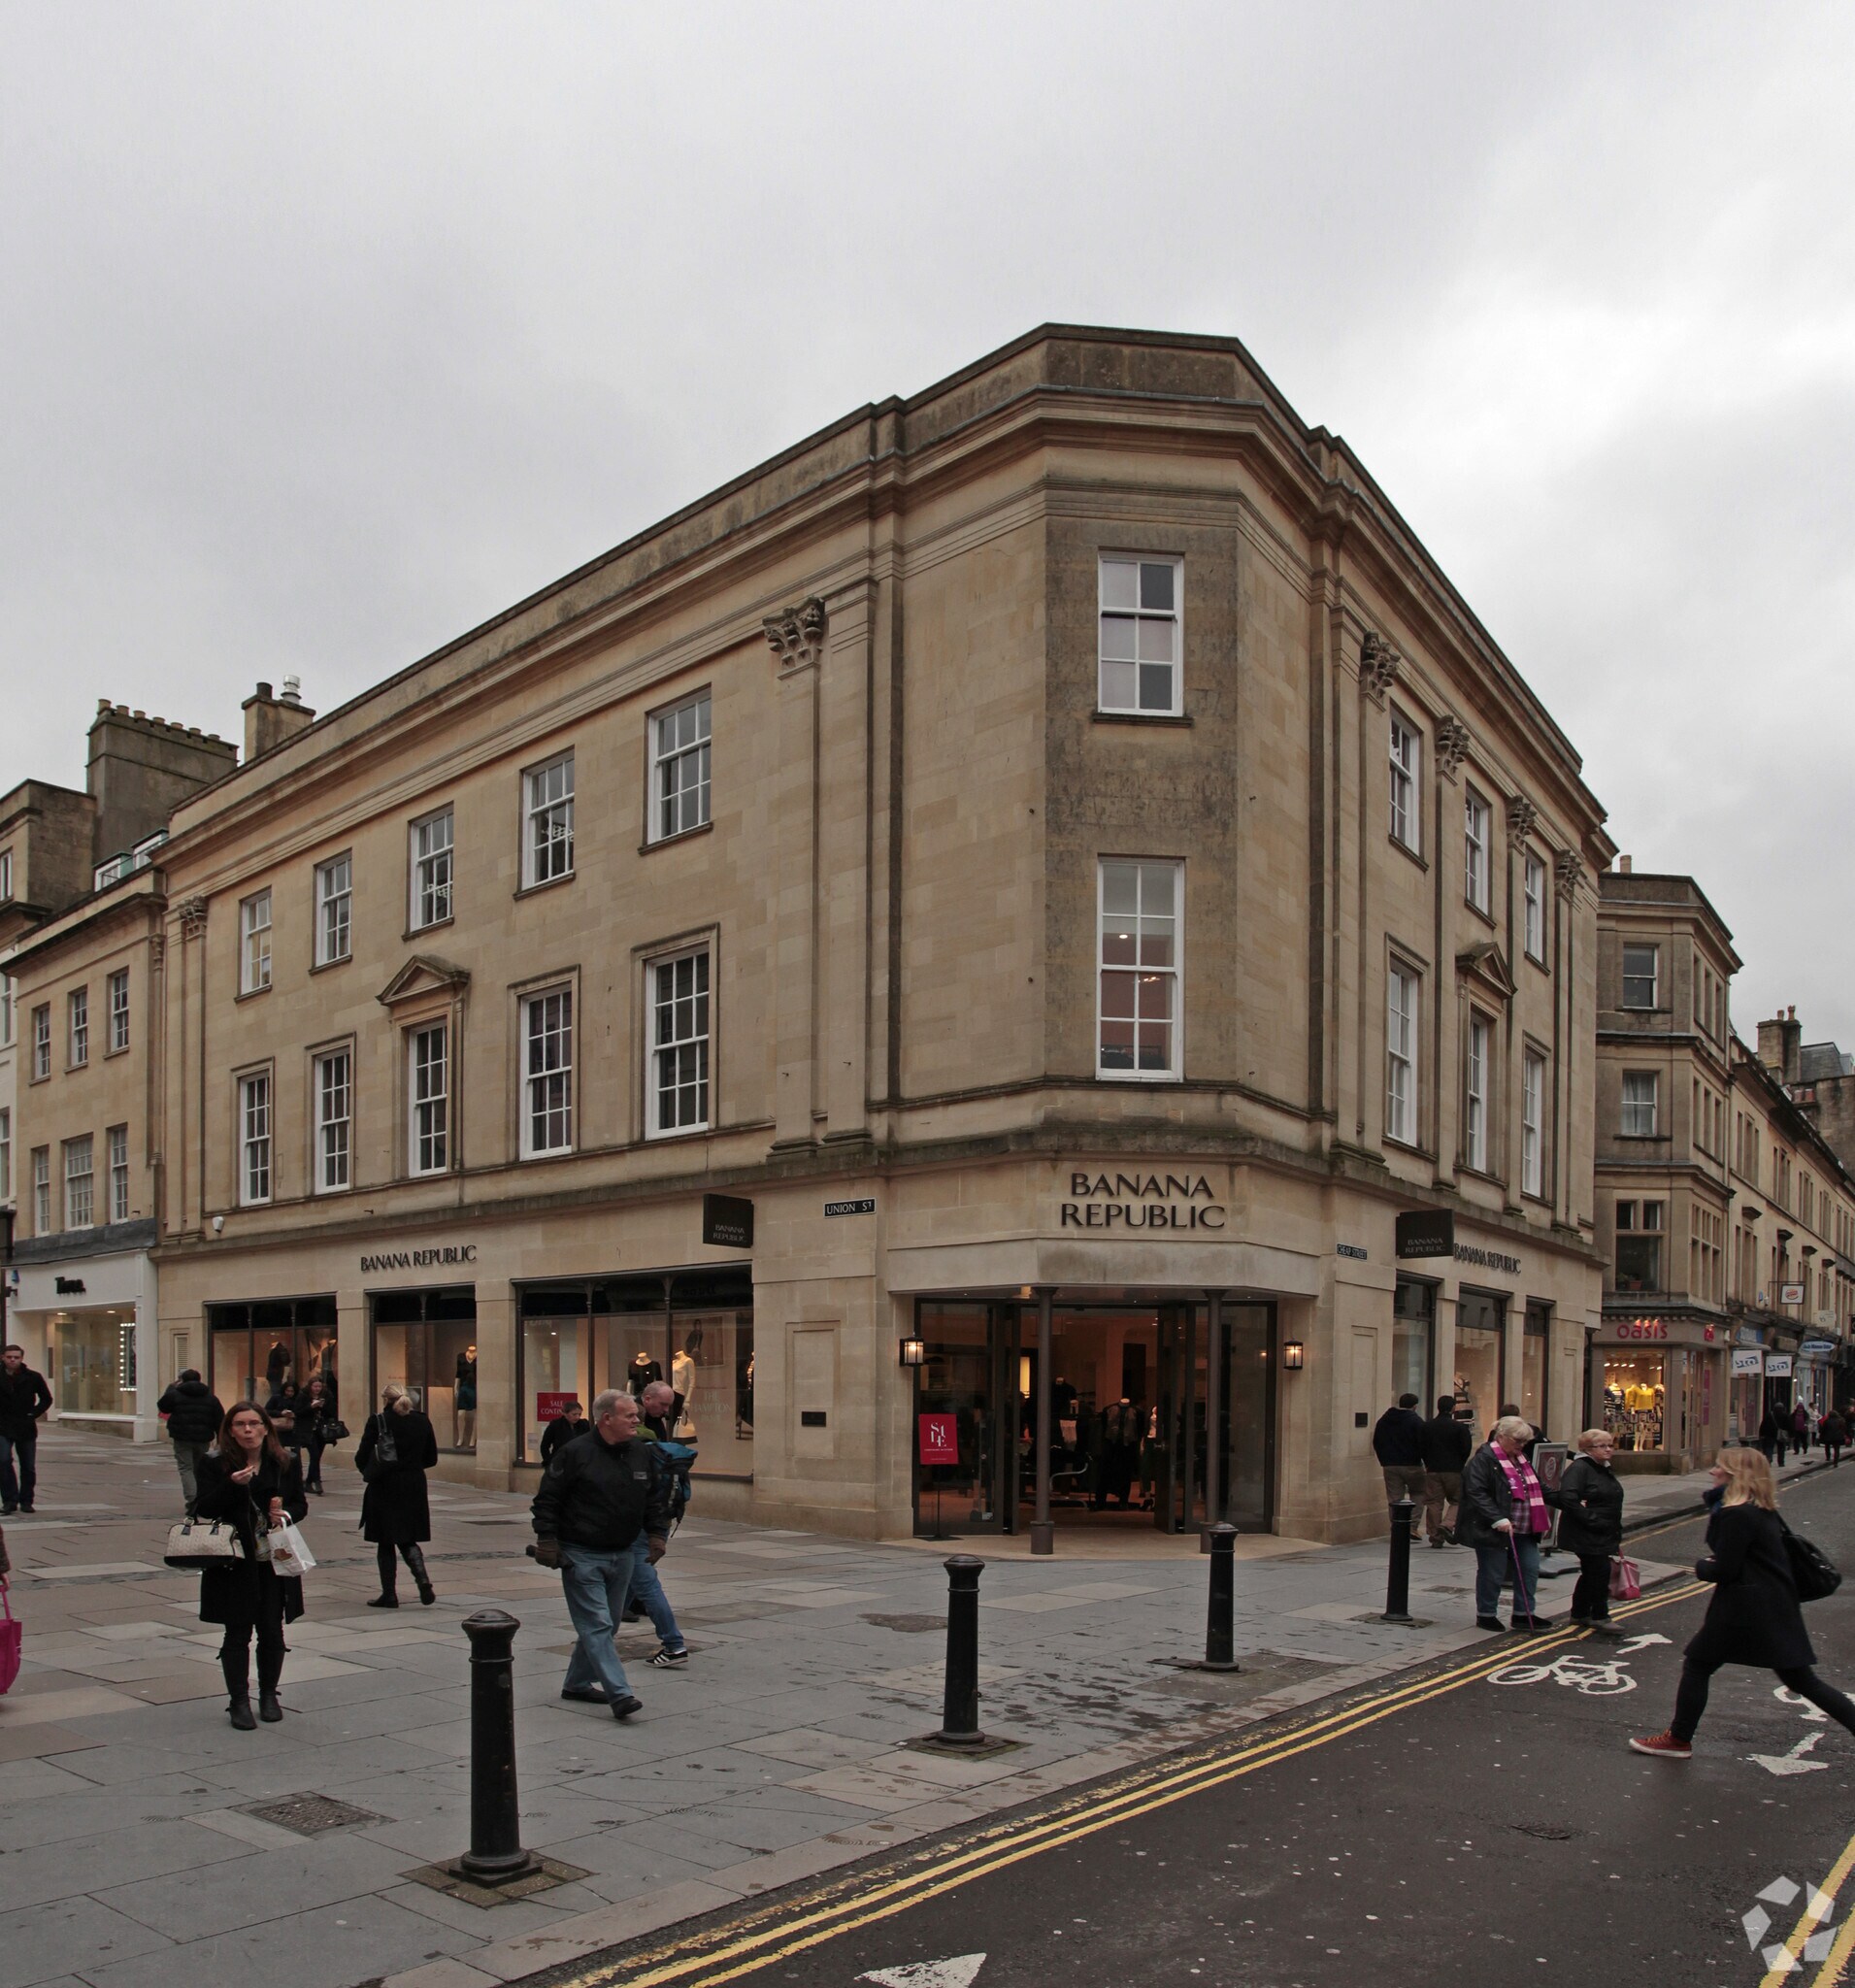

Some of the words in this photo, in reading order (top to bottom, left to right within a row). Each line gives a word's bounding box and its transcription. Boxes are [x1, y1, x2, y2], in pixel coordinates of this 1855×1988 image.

[1071, 1173, 1214, 1198] BANANA
[826, 1203, 856, 1214] UNION
[1061, 1203, 1225, 1228] REPUBLIC
[714, 1223, 745, 1235] BANANA
[712, 1232, 747, 1243] REPUBLIC
[1408, 1237, 1443, 1246] BANANA
[1405, 1244, 1445, 1254] REPUBLIC
[360, 1252, 411, 1272] BANANA
[414, 1244, 477, 1266] REPUBLIC
[1453, 1242, 1487, 1266] BANANA
[1487, 1251, 1521, 1274] REPUBLIC
